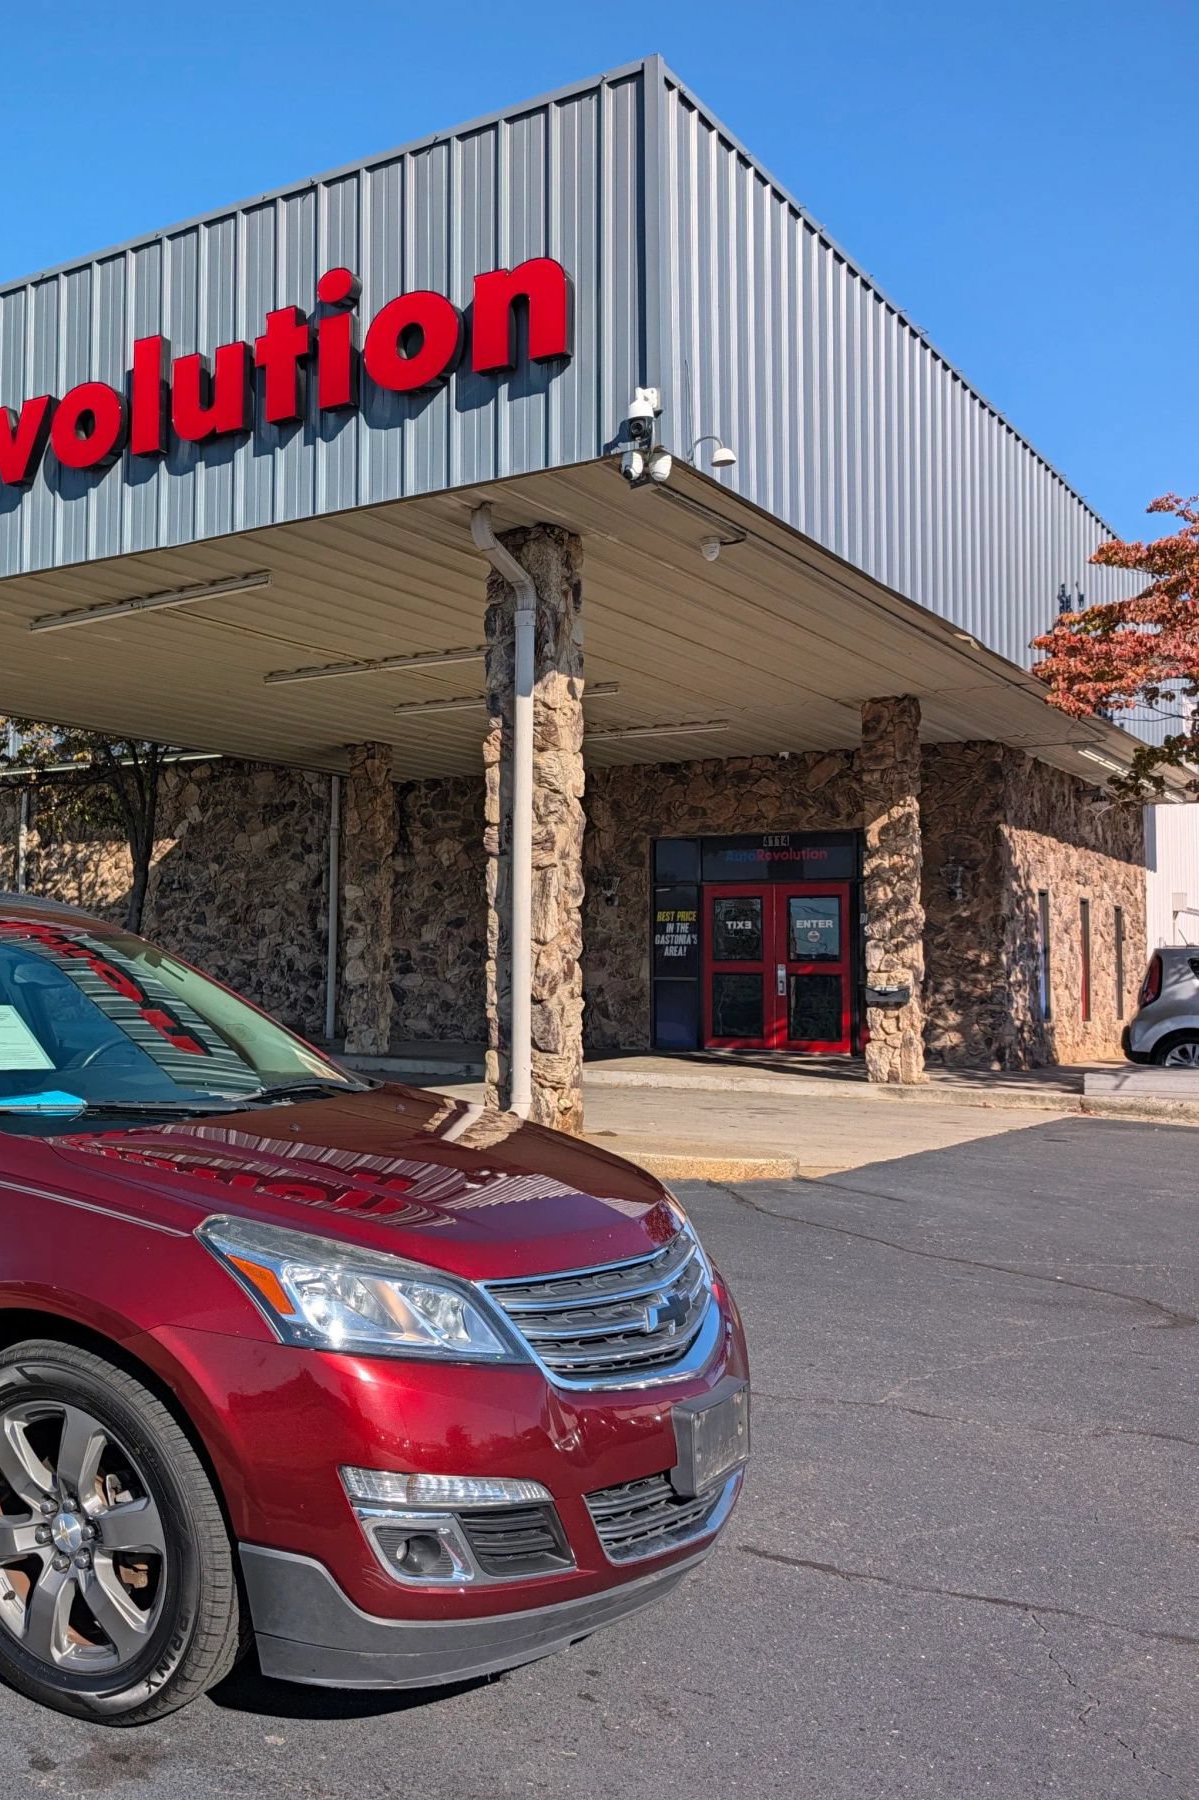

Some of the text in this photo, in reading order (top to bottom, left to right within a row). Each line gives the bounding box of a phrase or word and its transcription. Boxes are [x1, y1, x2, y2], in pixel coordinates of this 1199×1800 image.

[726, 848, 828, 862] AutoRevolution
[657, 910, 698, 922] BEST PRICE
[666, 922, 690, 934] IN THE
[796, 919, 834, 928] ENTER
[654, 934, 699, 945] GASTONIA'S
[663, 945, 687, 957] AREA!
[144, 1615, 190, 1695] PRINX
